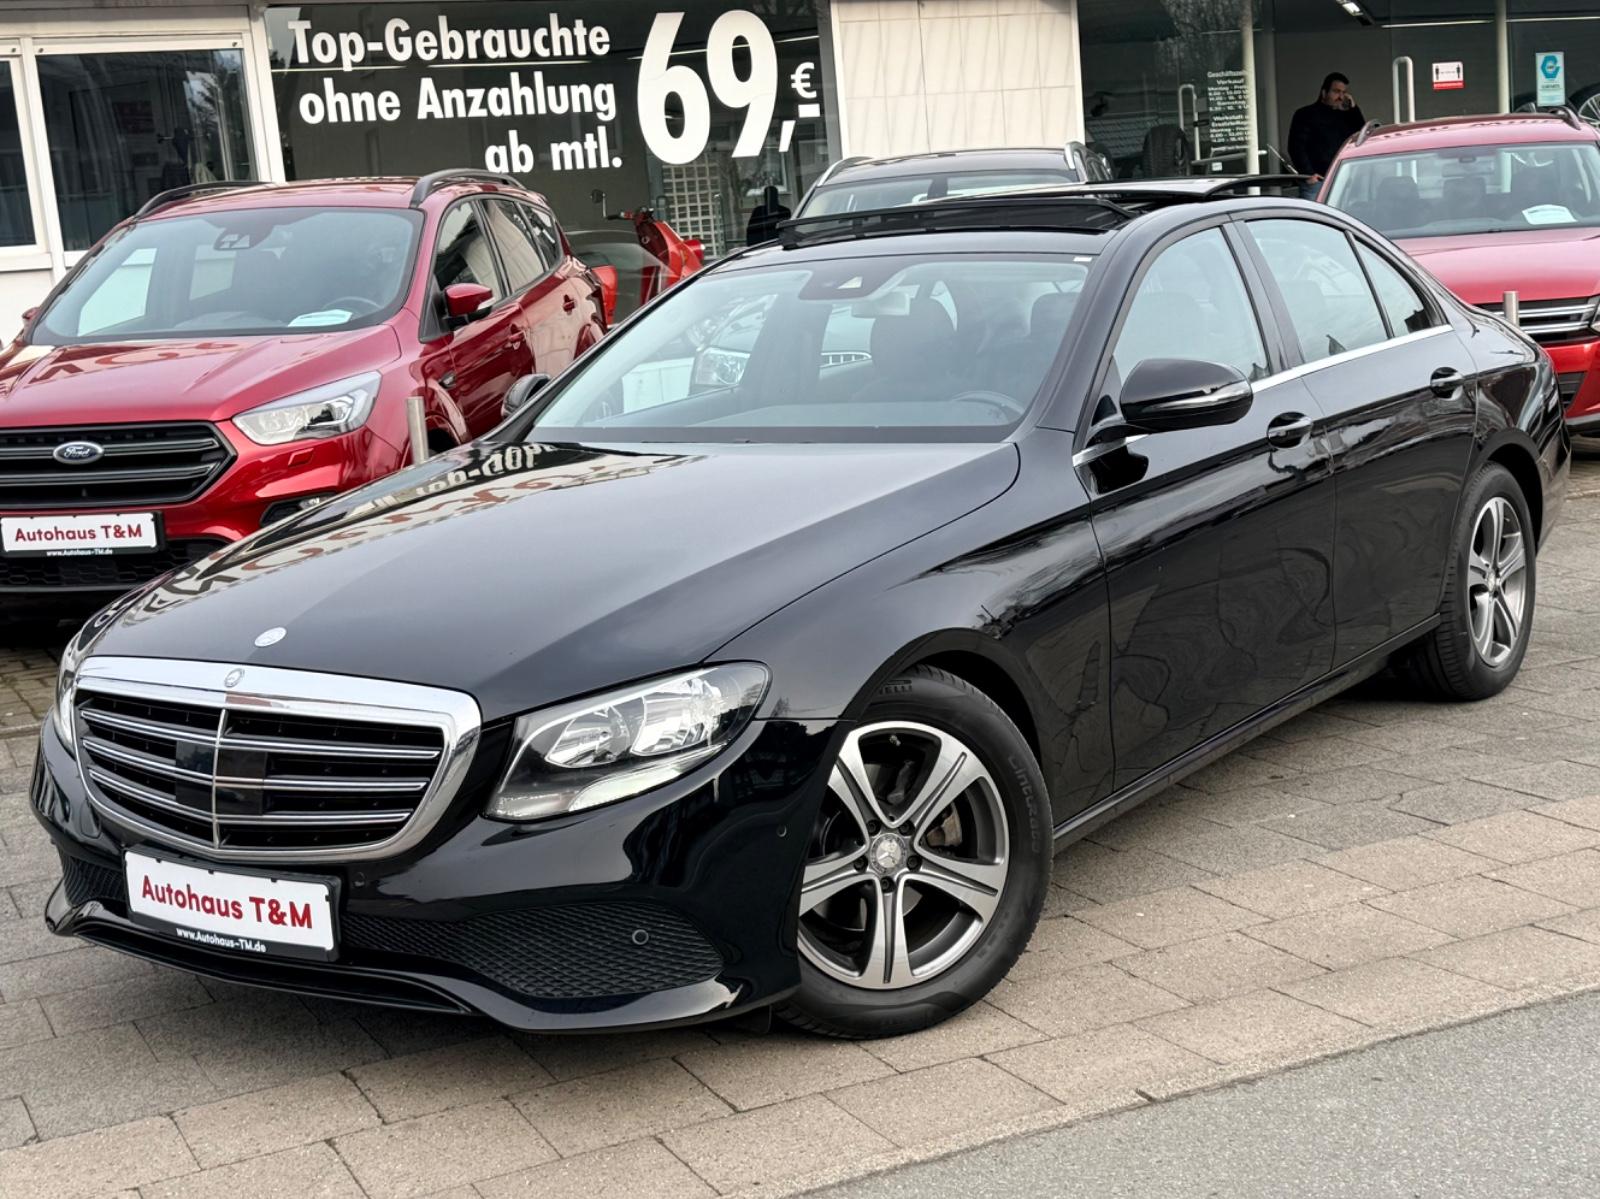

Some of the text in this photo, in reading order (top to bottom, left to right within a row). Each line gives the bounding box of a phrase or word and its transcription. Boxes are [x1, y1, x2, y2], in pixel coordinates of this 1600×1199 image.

[288, 13, 611, 71] Top-Gebrauchte
[299, 71, 617, 125] ohne Anzahlung
[484, 126, 623, 174] ab mtl.
[64, 445, 90, 458] Ford
[15, 524, 143, 543] Autohaus T&M
[142, 874, 313, 930] Autohaus T&M
[176, 928, 267, 953] www.Autohaus-TM.de
